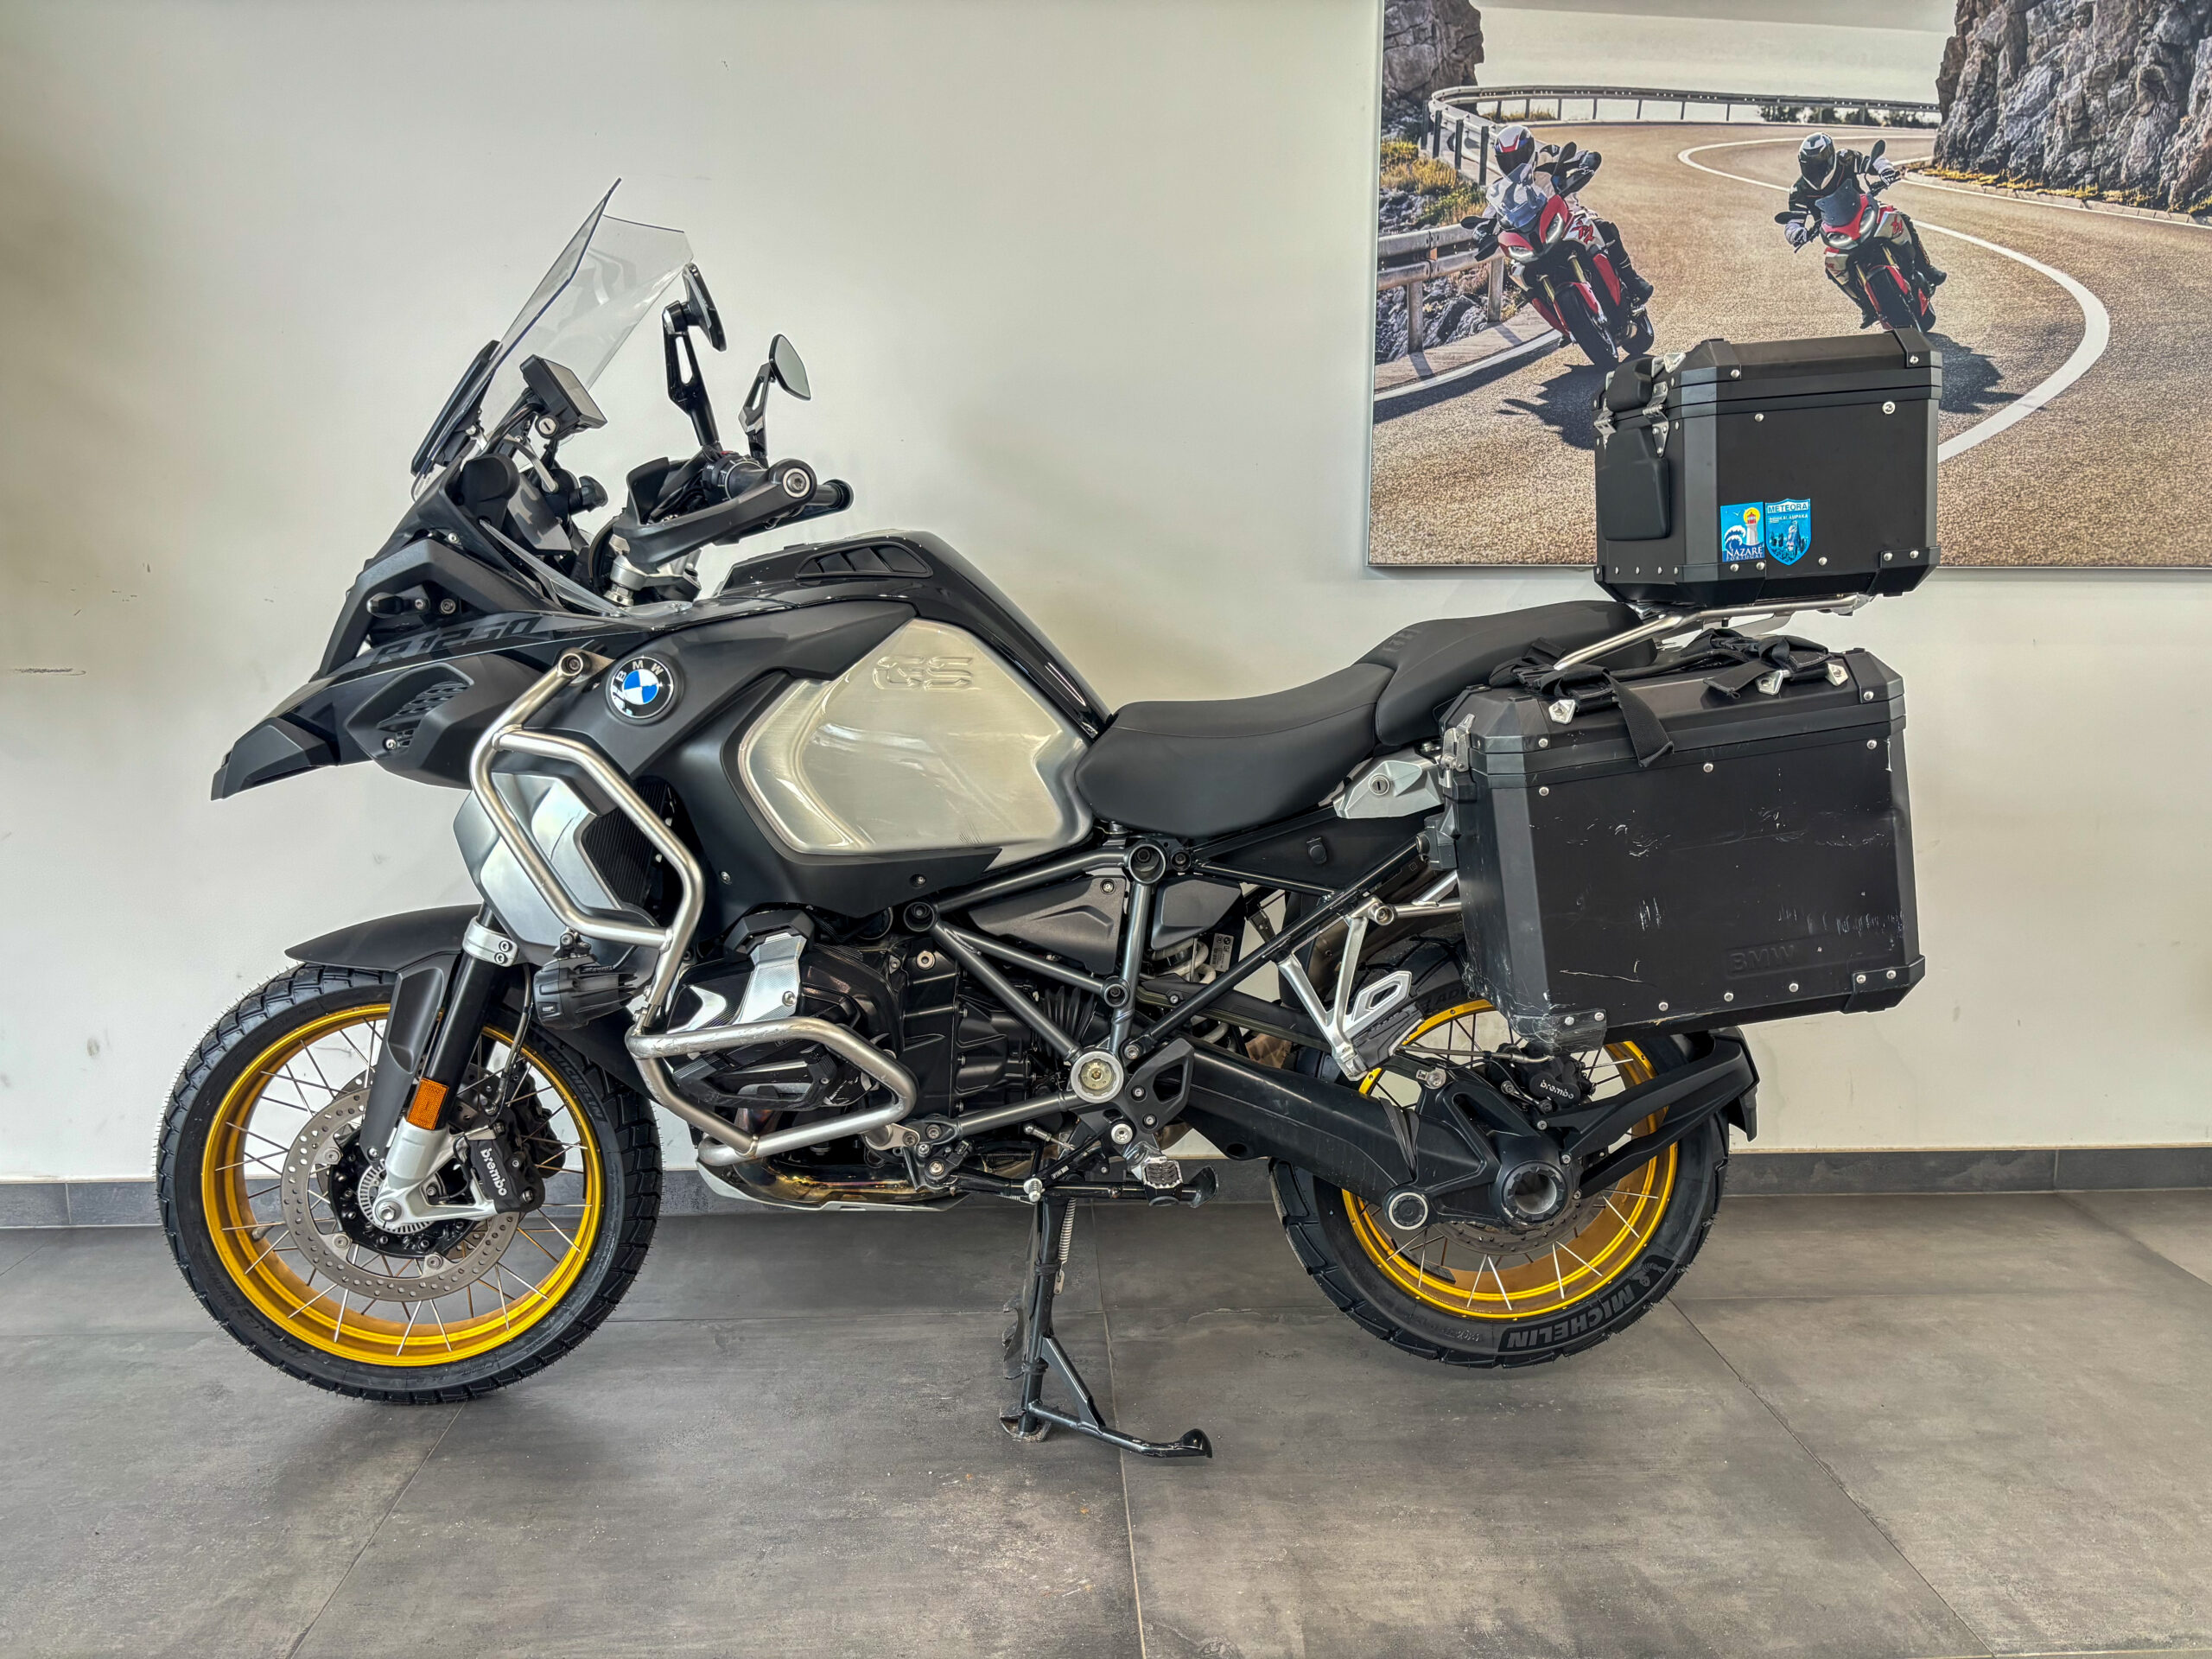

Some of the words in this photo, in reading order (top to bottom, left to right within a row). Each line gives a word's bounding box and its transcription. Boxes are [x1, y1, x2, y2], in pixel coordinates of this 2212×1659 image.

[1768, 503, 1808, 512] METEORA
[1726, 544, 1763, 557] NAZARÉ
[615, 659, 664, 683] BMW
[873, 656, 973, 690] GS
[1730, 944, 1794, 970] BMW
[1540, 1079, 1574, 1099] brembo
[480, 1147, 507, 1196] brembo
[1507, 1284, 1635, 1348] MICHELIN
